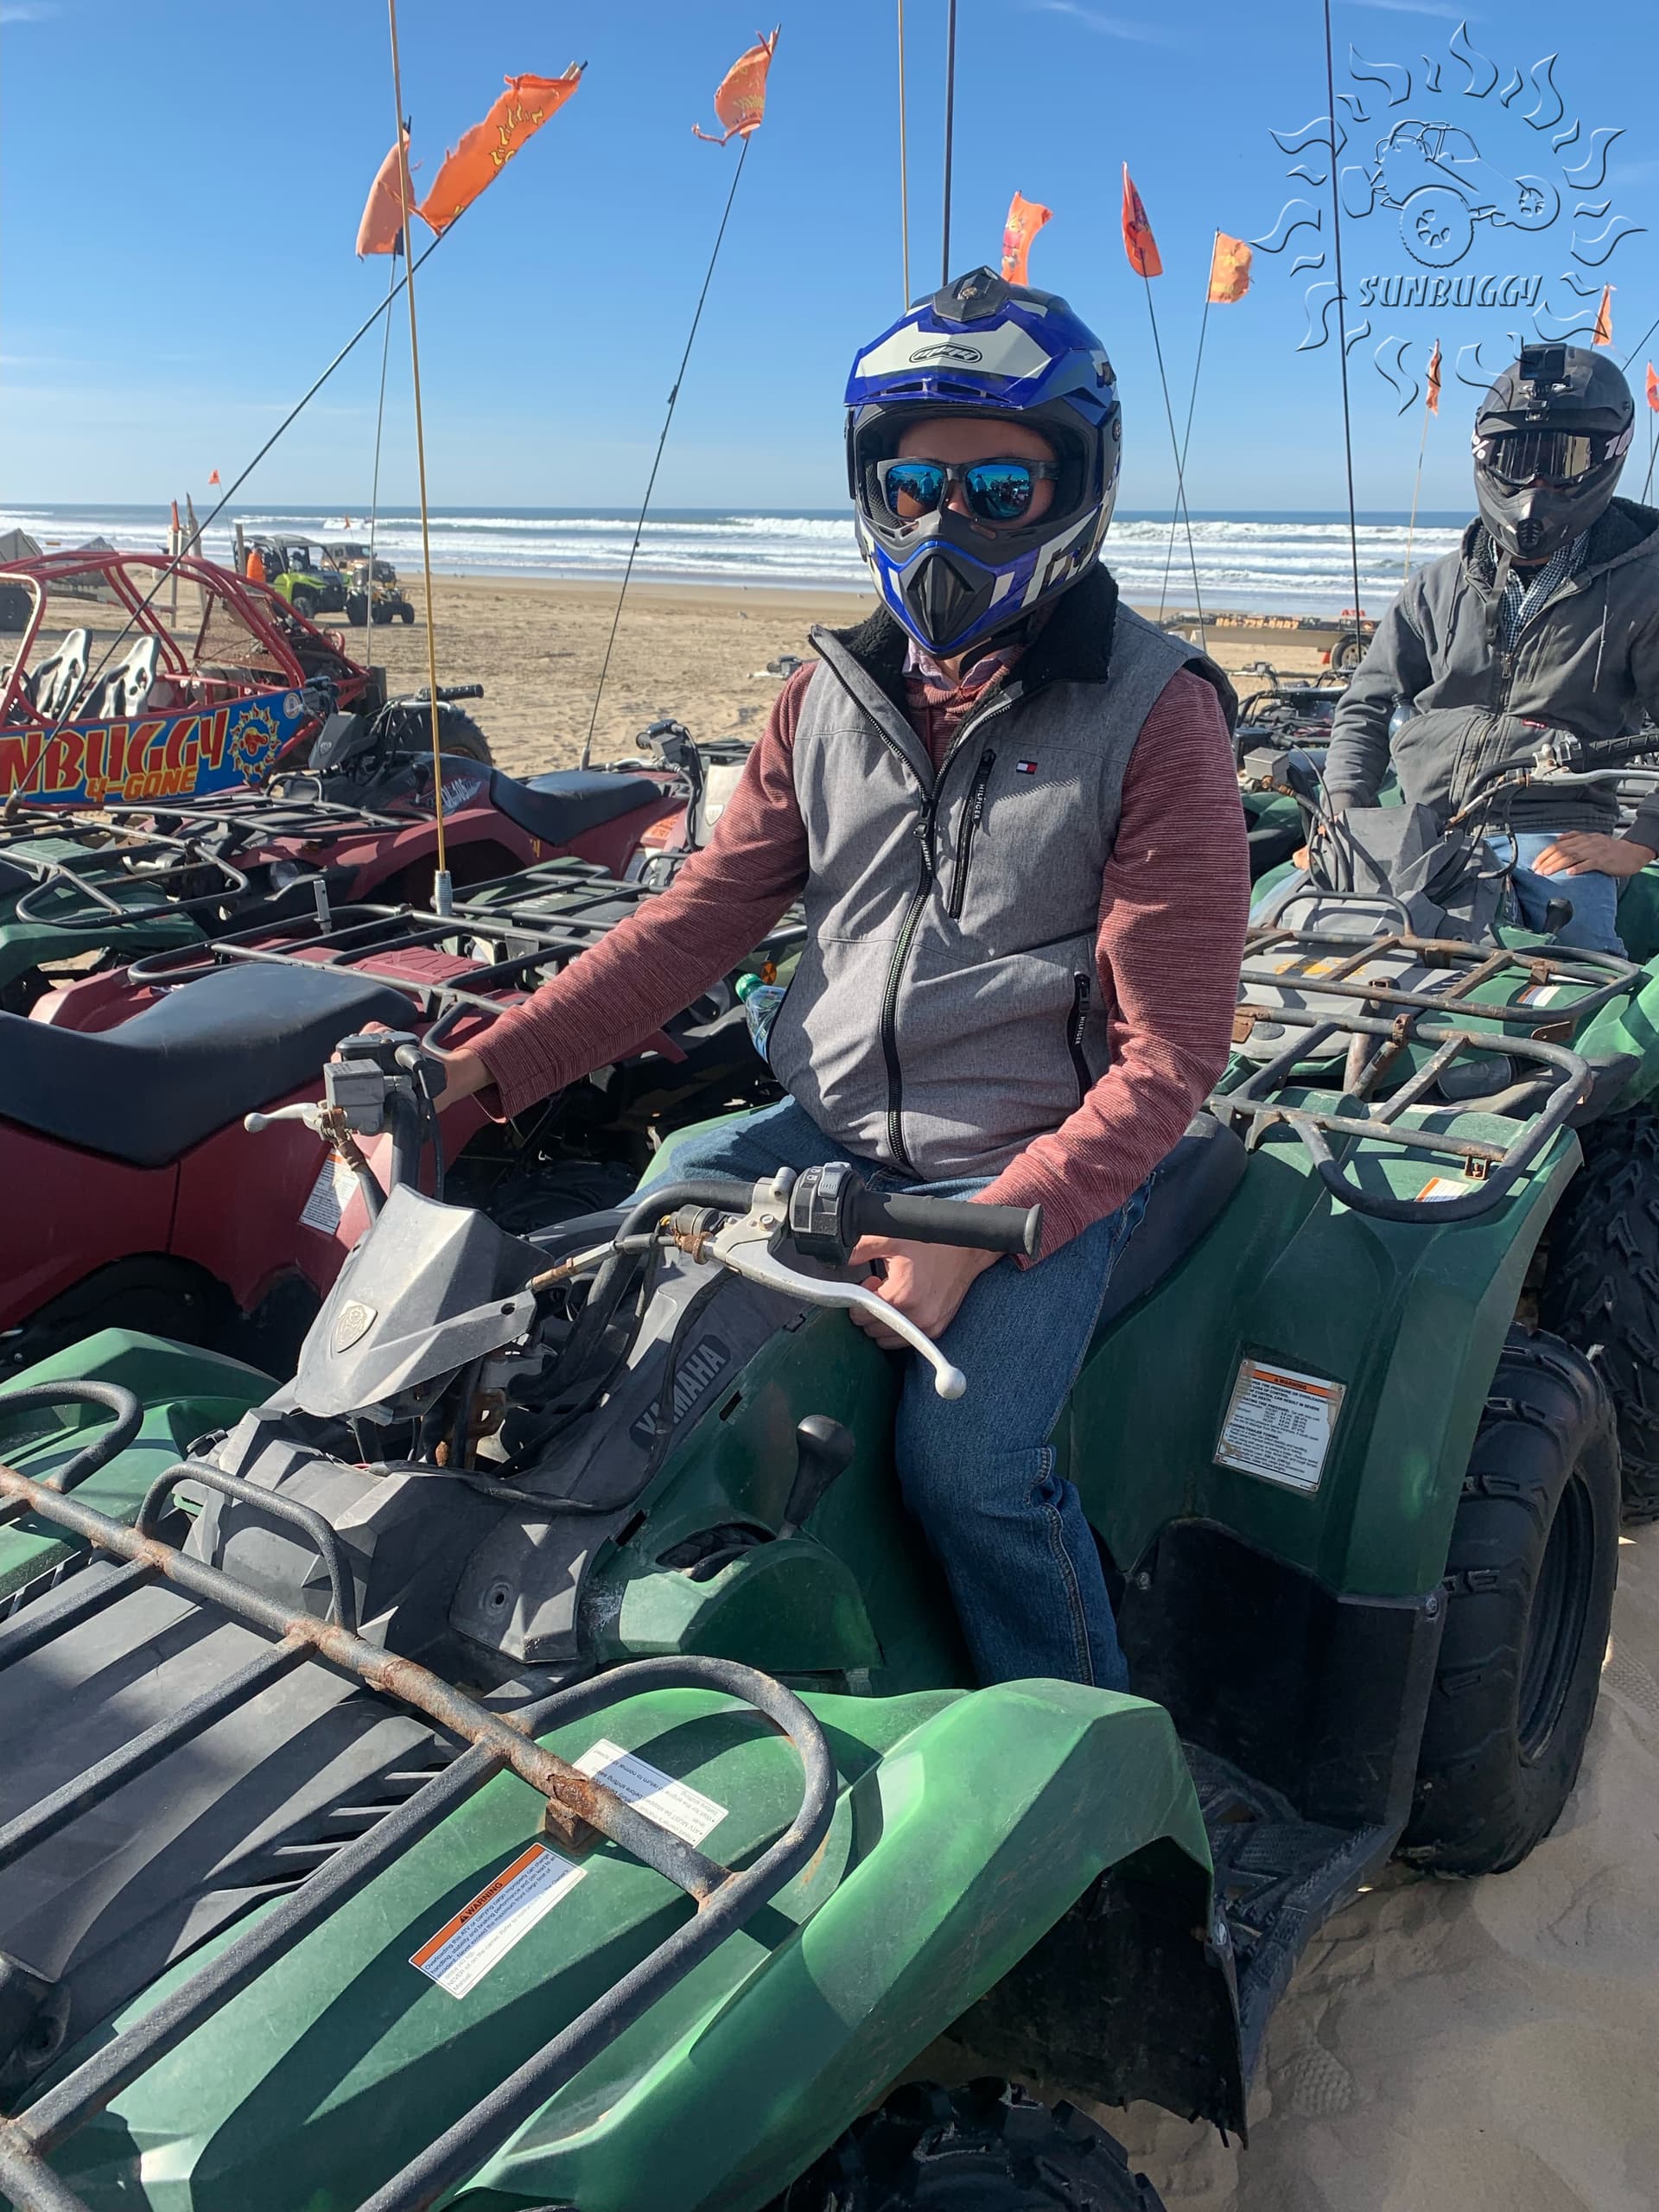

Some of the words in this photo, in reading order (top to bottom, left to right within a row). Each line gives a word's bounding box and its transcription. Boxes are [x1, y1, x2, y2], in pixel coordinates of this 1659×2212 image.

[86, 766, 198, 805] 4-GONE
[974, 784, 985, 819] HILFIGER
[636, 1344, 726, 1434] YMAHA
[1278, 1378, 1307, 1390] WARNING
[464, 1881, 503, 1916] WARNING
